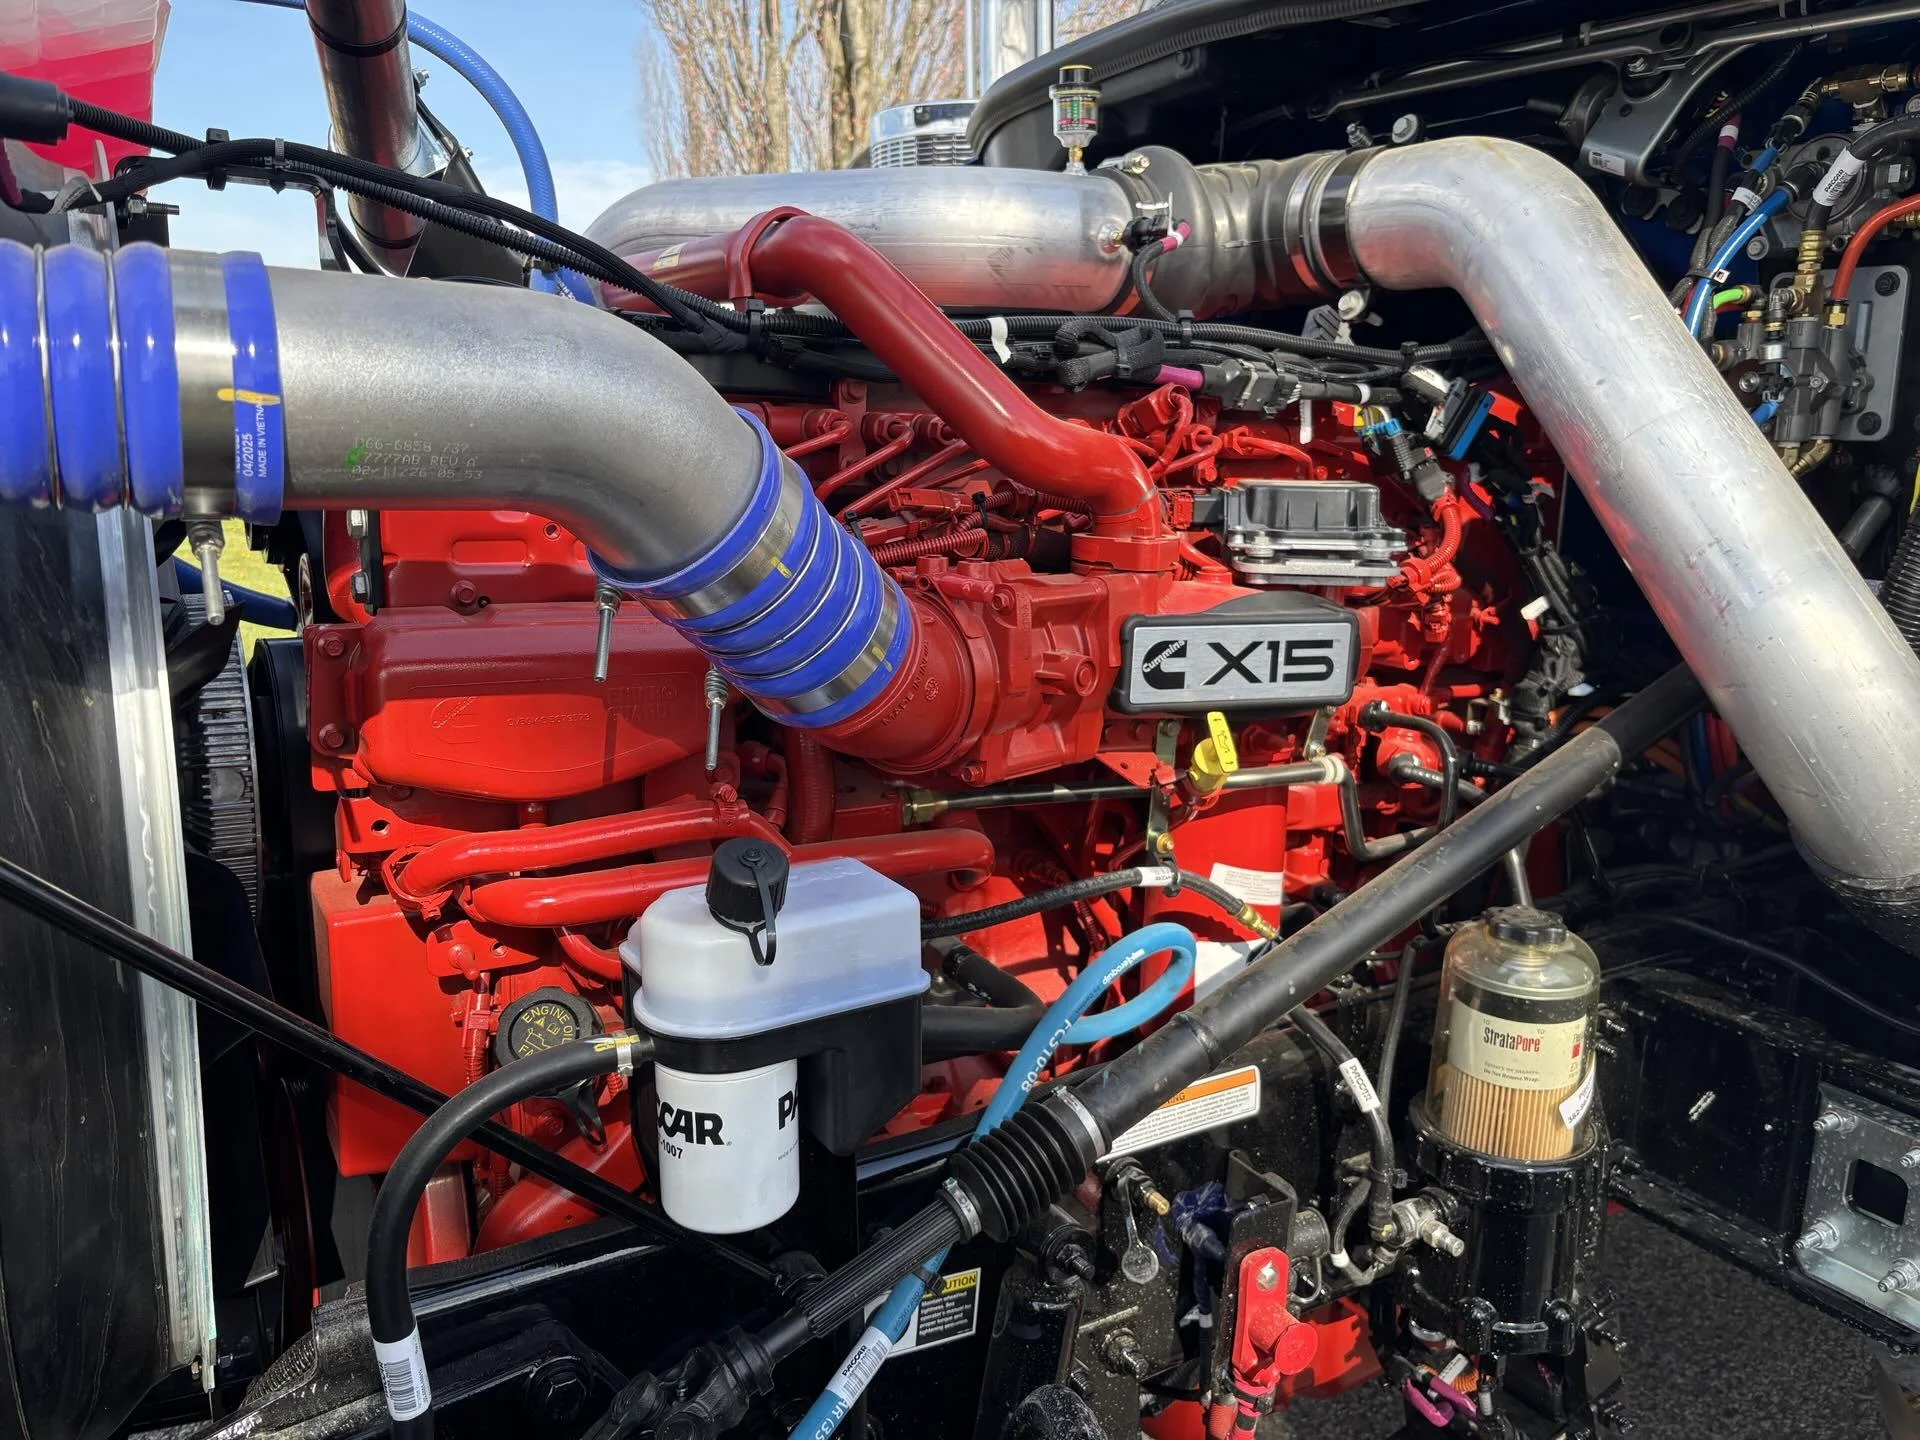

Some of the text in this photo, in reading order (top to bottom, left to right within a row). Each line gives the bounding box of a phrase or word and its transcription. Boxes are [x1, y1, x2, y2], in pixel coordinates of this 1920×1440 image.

[1824, 169, 1844, 192] PACCAR
[256, 397, 267, 477] MADE IN VIETNA
[241, 432, 254, 477] 04/2025
[1142, 639, 1335, 686] Cummins X15
[521, 1005, 571, 1025] ENGINE
[1021, 1018, 1073, 1093] FC510-08
[1483, 1026, 1541, 1053] StrataPore
[945, 1274, 976, 1289] UTION
[841, 1344, 867, 1377] PACCAR
